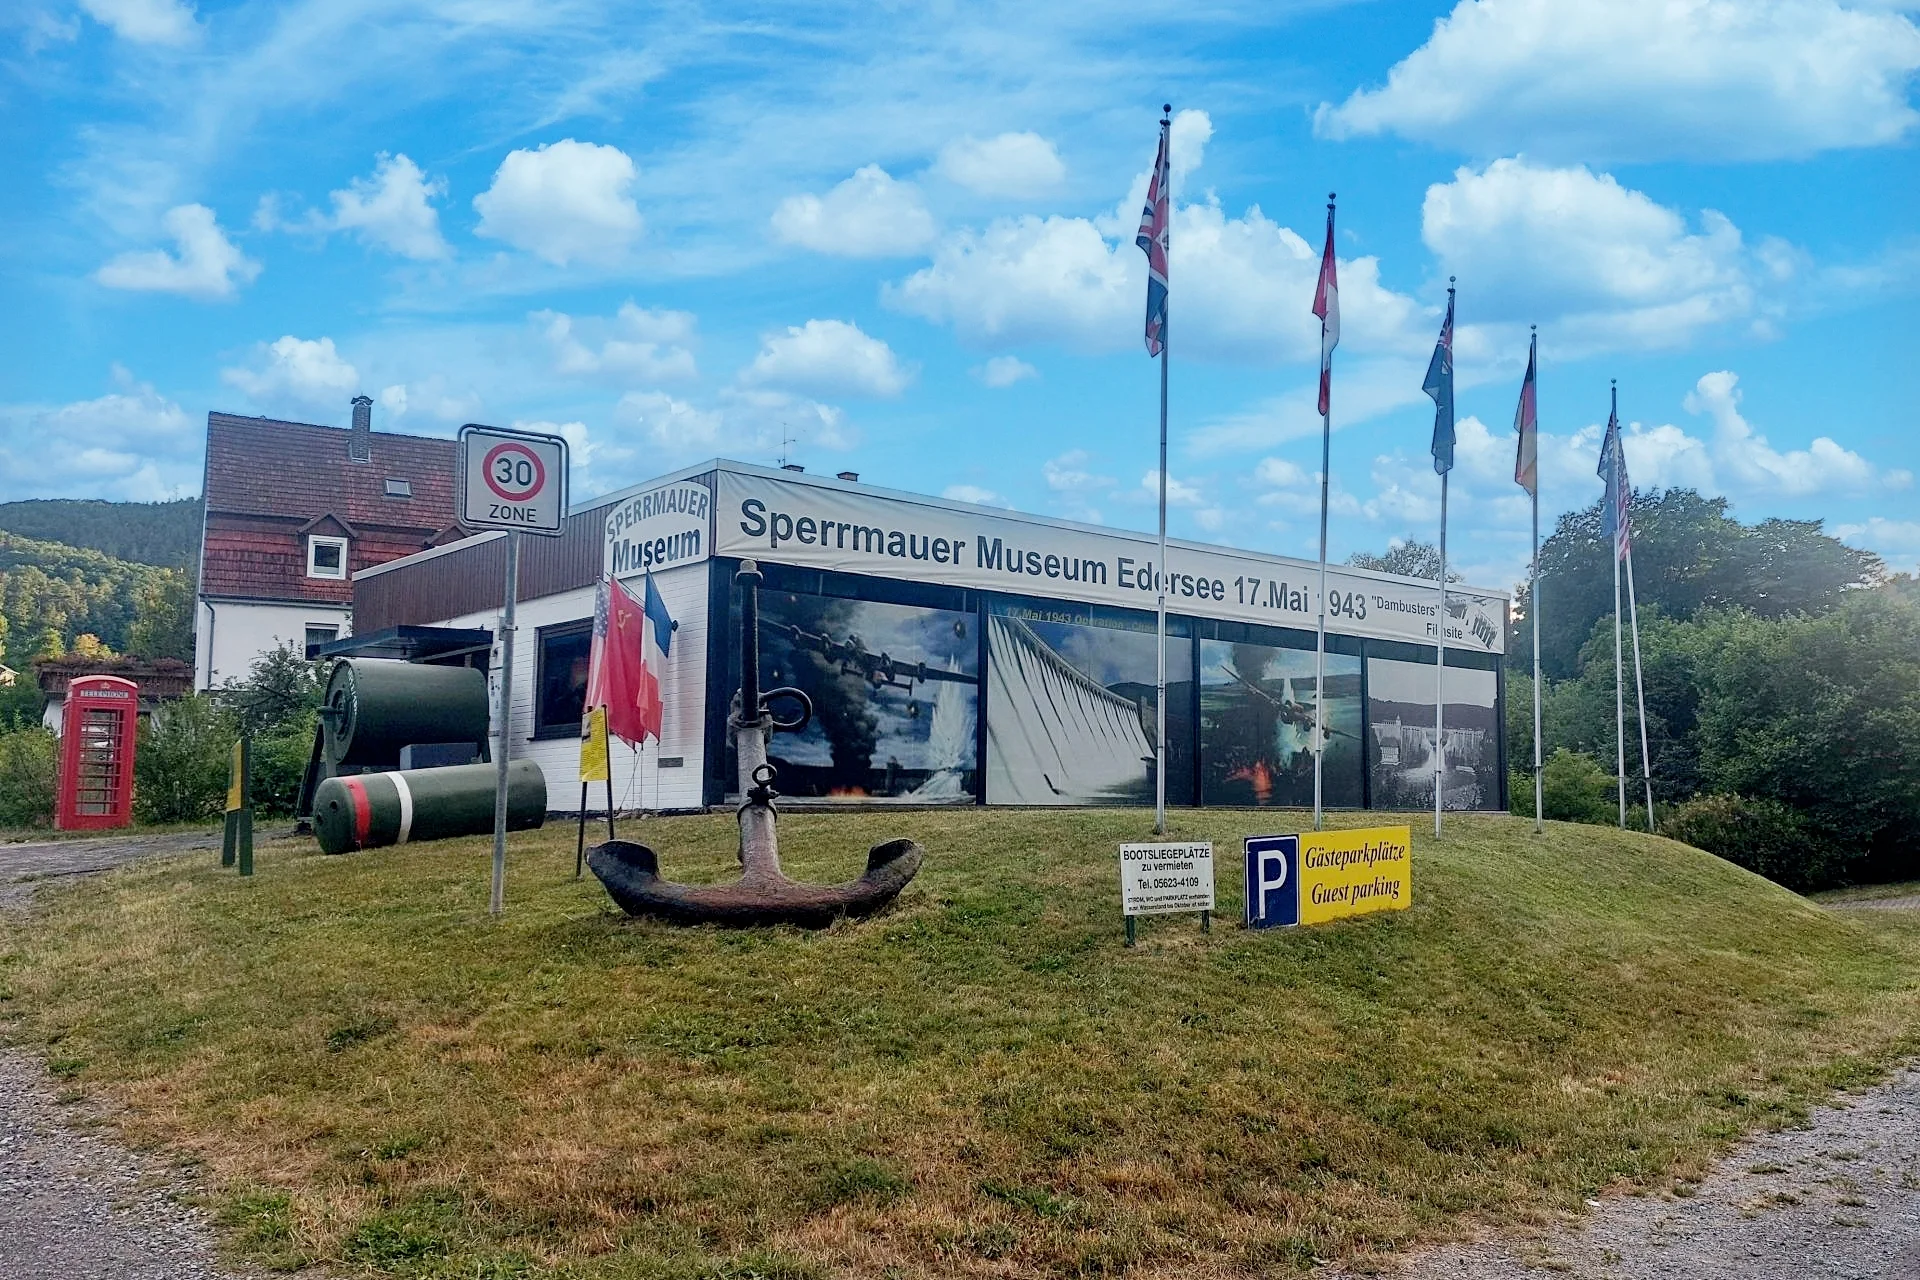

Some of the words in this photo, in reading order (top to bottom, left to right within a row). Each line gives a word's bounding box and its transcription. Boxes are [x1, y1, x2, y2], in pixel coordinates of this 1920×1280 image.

[496, 457, 532, 487] 30
[489, 504, 537, 523] ZONE
[606, 487, 708, 544] SPERRMAUER
[612, 527, 701, 574] Museum
[740, 498, 966, 565] Sperrmauer
[976, 535, 1107, 585] Museum
[1234, 575, 1309, 613] 17.Mai
[1316, 590, 1367, 620] 943
[1371, 595, 1440, 617] "Dambusters"
[84, 690, 126, 698] TELEPHONE
[1123, 847, 1210, 861] BOOTSLIEGEPLÄTZE
[1141, 863, 1152, 872] zu
[1153, 861, 1194, 872] vermieten
[1305, 841, 1406, 871] Gästeparkplätze
[1138, 879, 1152, 890] Tel.
[1153, 877, 1199, 889] 05623-4109
[1257, 850, 1288, 920] P
[1311, 881, 1350, 905] Guest
[1351, 876, 1401, 906] parking
